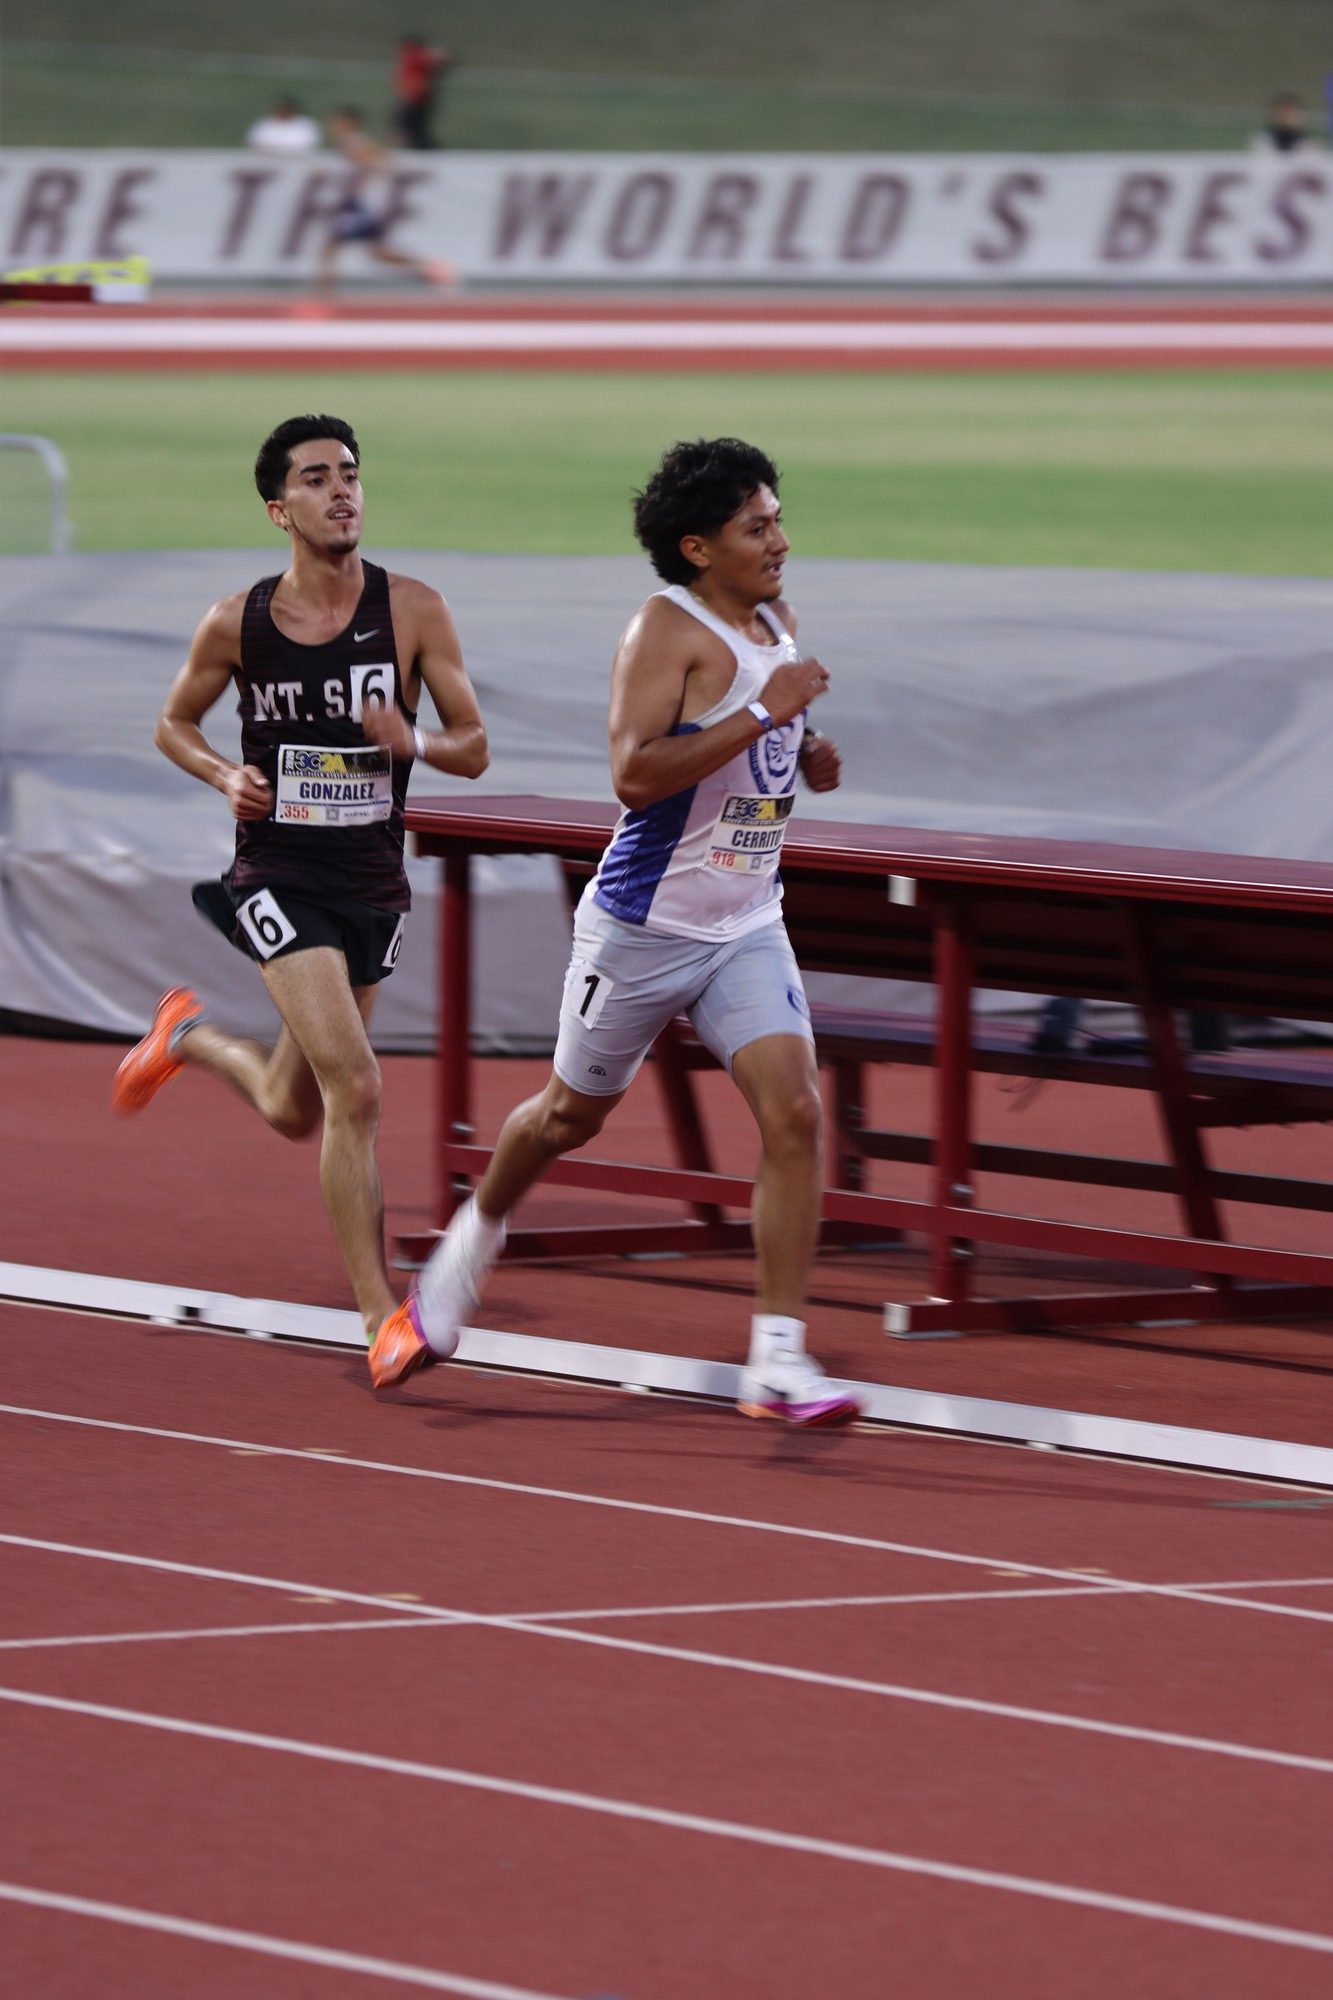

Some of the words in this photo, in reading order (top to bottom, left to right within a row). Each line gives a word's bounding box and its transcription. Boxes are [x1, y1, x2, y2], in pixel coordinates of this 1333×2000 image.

[0, 167, 156, 261] RE
[489, 170, 1045, 264] WORLD'S
[251, 681, 314, 721] MT.
[361, 669, 386, 713] 6
[299, 782, 375, 801] GONZALEZ
[284, 805, 309, 820] 355
[732, 828, 784, 848] CERRITO
[712, 851, 735, 868] 918
[248, 900, 283, 946] 6
[580, 975, 600, 1017] 1
